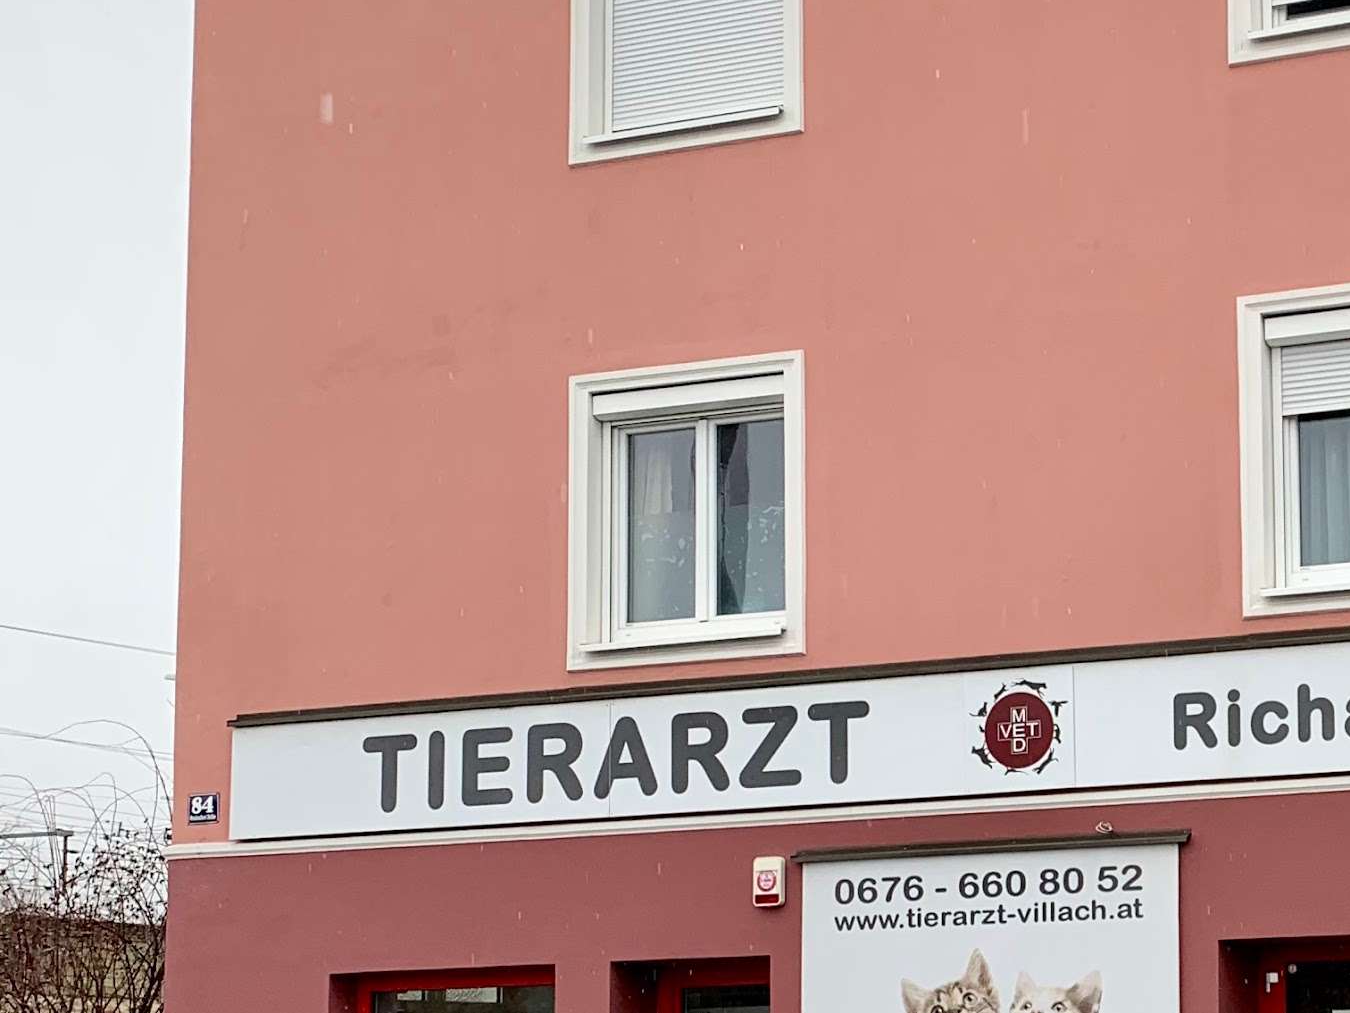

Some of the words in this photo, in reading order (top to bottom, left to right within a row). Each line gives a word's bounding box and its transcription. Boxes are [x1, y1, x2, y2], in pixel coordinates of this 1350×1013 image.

[1000, 722, 1038, 739] VET
[362, 700, 871, 813] TIERARZT
[191, 795, 215, 815] 84
[835, 875, 924, 904] 0676
[958, 870, 1027, 899] 660
[1039, 868, 1084, 896] 80
[1097, 864, 1143, 893] 52
[834, 898, 1144, 932] www.tierarzt-villach.at
